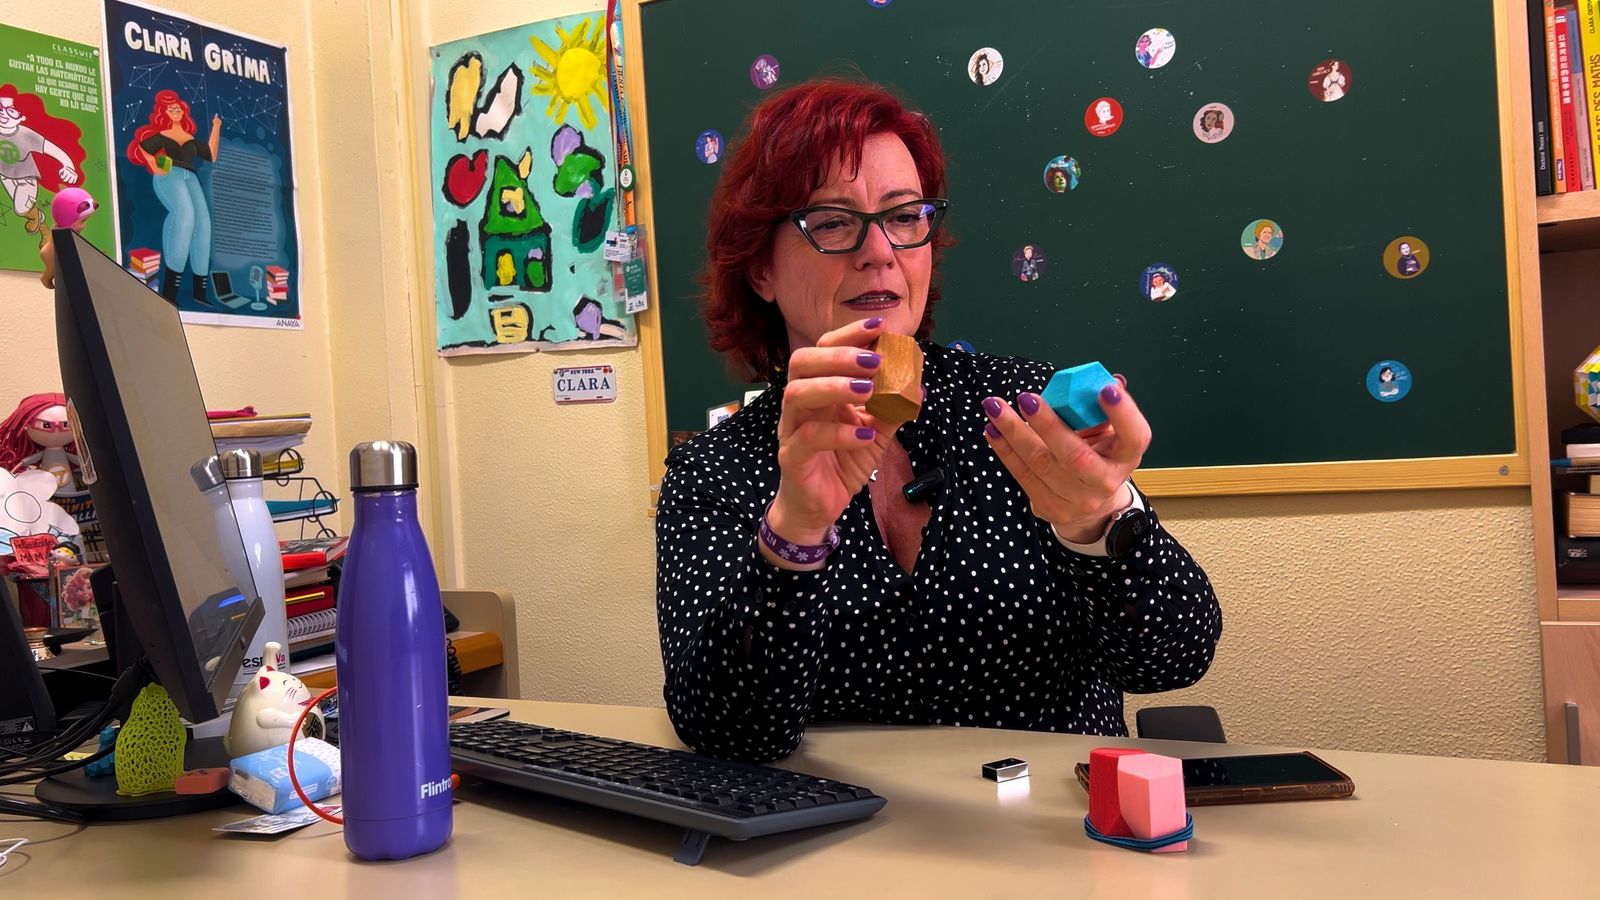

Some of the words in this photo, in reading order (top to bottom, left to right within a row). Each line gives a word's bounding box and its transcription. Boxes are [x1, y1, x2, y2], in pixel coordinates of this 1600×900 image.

[124, 21, 193, 62] CLARA
[204, 42, 271, 85] GRIMA
[9, 59, 35, 72] GUSTAN
[36, 66, 49, 75] LAS
[36, 55, 54, 67] TODO
[55, 60, 64, 69] EL
[65, 62, 88, 75] MUNDO
[88, 68, 97, 76] LE
[35, 84, 48, 94] HAY
[49, 87, 71, 99] GENTE
[72, 91, 85, 101] QUE
[46, 78, 57, 87] QUE
[88, 87, 98, 95] QUE
[60, 98, 69, 107] NO
[70, 100, 79, 109] LO
[276, 319, 300, 328] ANAYA
[557, 376, 611, 392] CLARA
